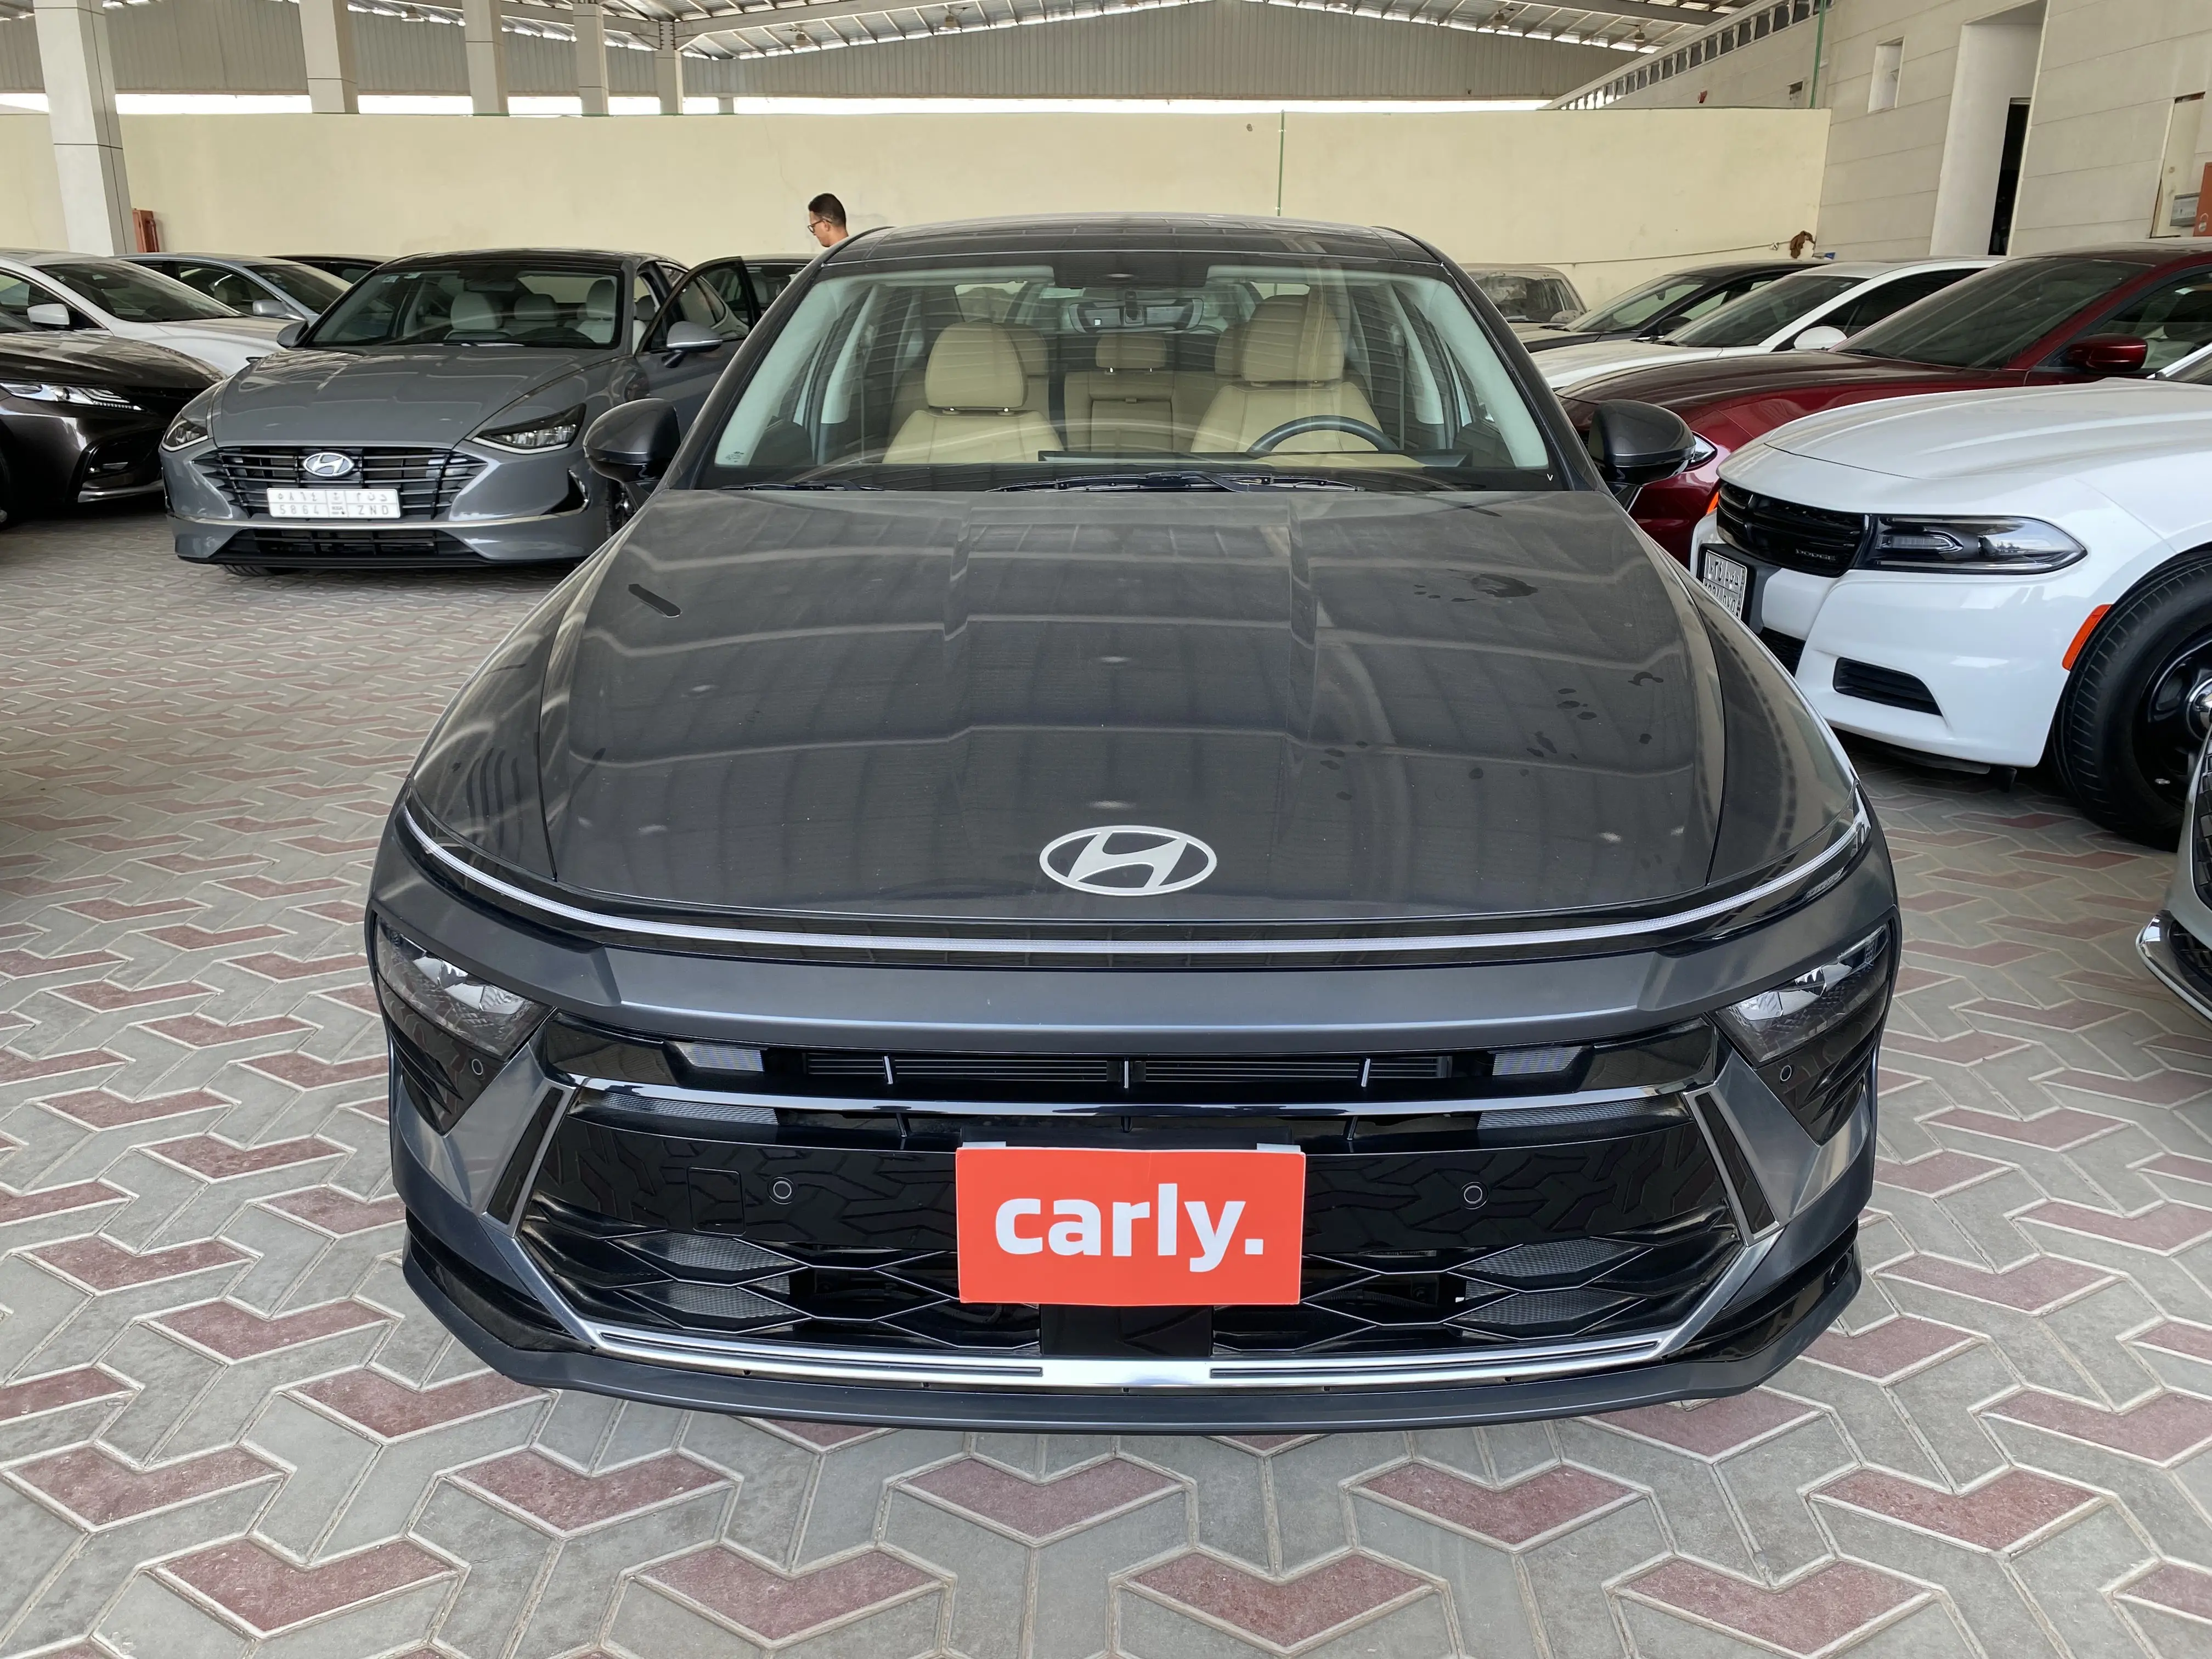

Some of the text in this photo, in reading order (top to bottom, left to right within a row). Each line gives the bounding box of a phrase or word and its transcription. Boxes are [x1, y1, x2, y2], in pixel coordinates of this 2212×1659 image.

[279, 505, 319, 515] 5864
[357, 505, 389, 515] ZND
[1796, 548, 1836, 560] DODGE
[995, 1183, 1263, 1273] carly.
